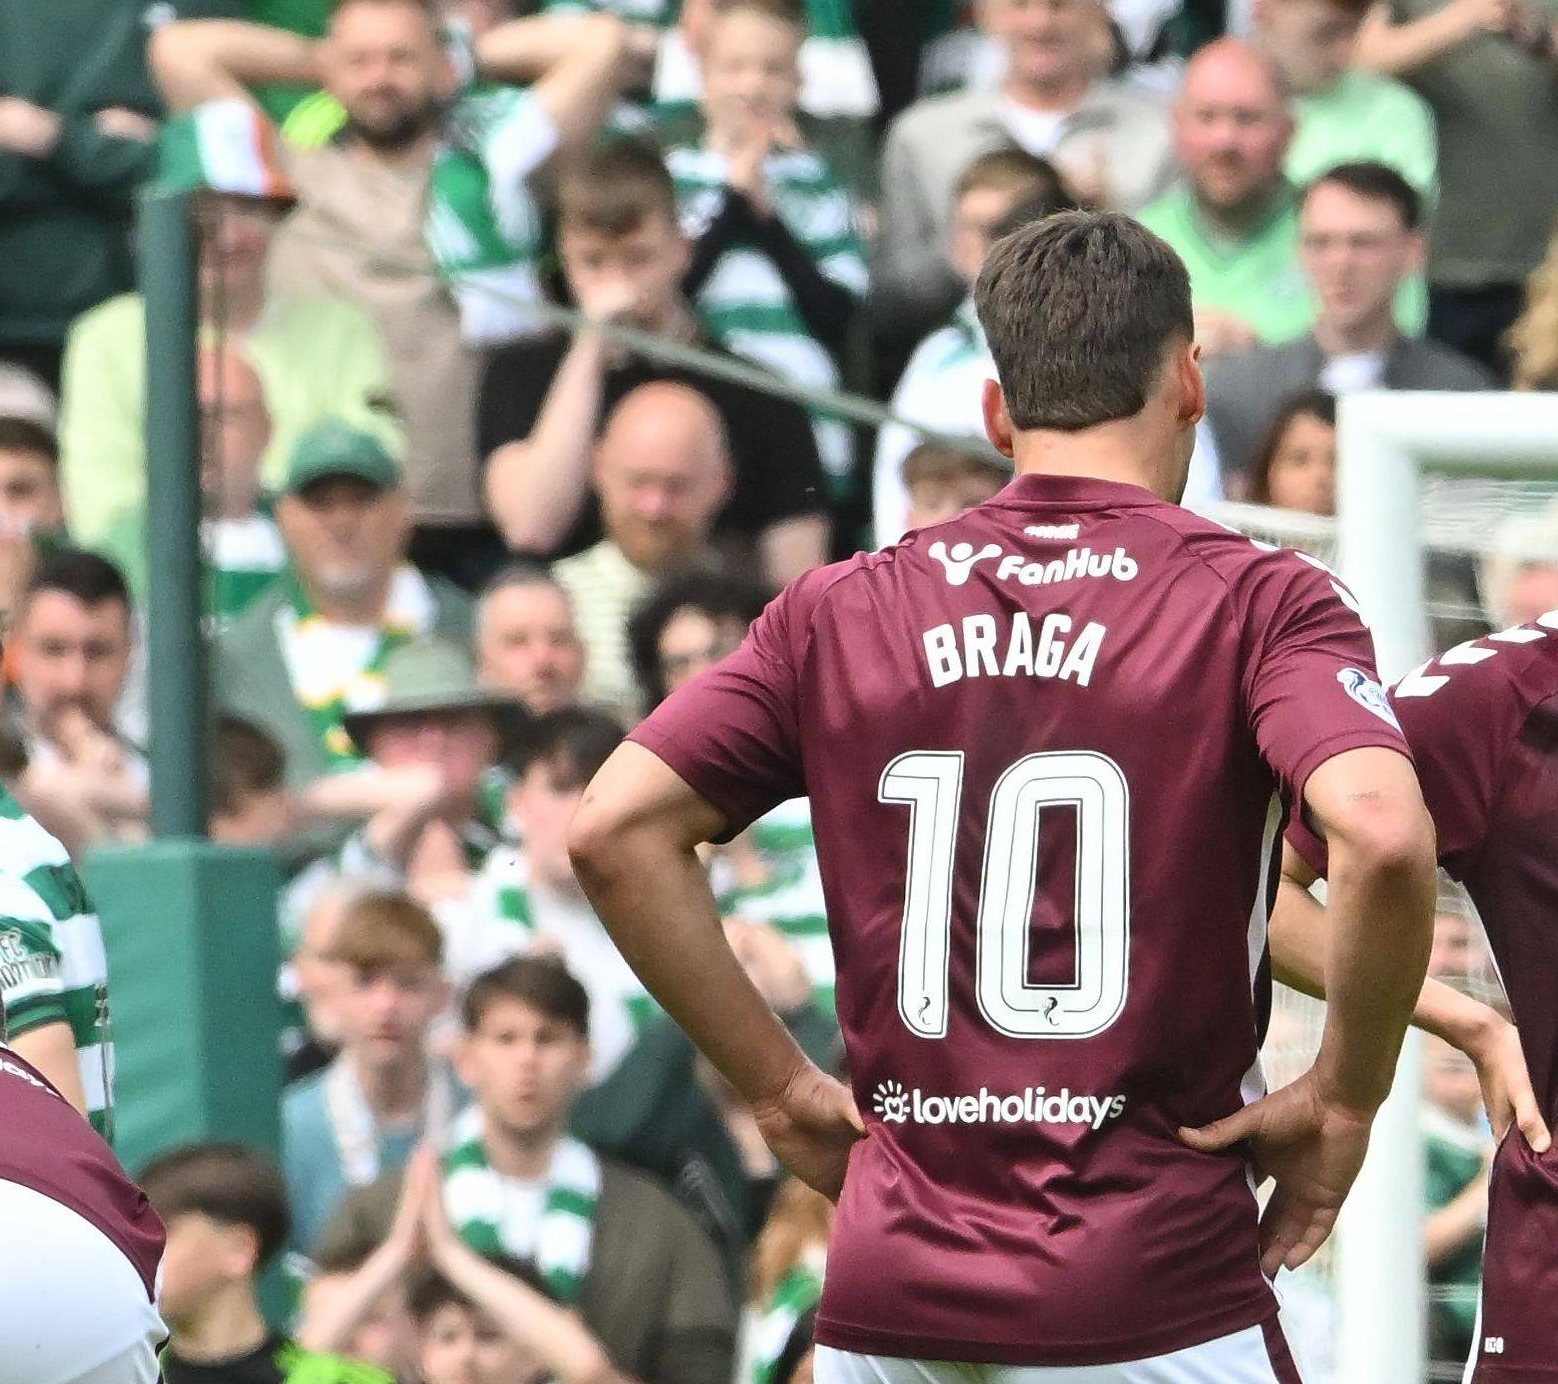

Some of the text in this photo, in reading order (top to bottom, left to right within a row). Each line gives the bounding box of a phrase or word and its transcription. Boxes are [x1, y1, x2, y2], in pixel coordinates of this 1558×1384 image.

[996, 547, 1138, 586] FanHub
[922, 611, 1107, 689] BRAGA
[876, 749, 1131, 1040] 10
[912, 1087, 1127, 1131] loveholidays
